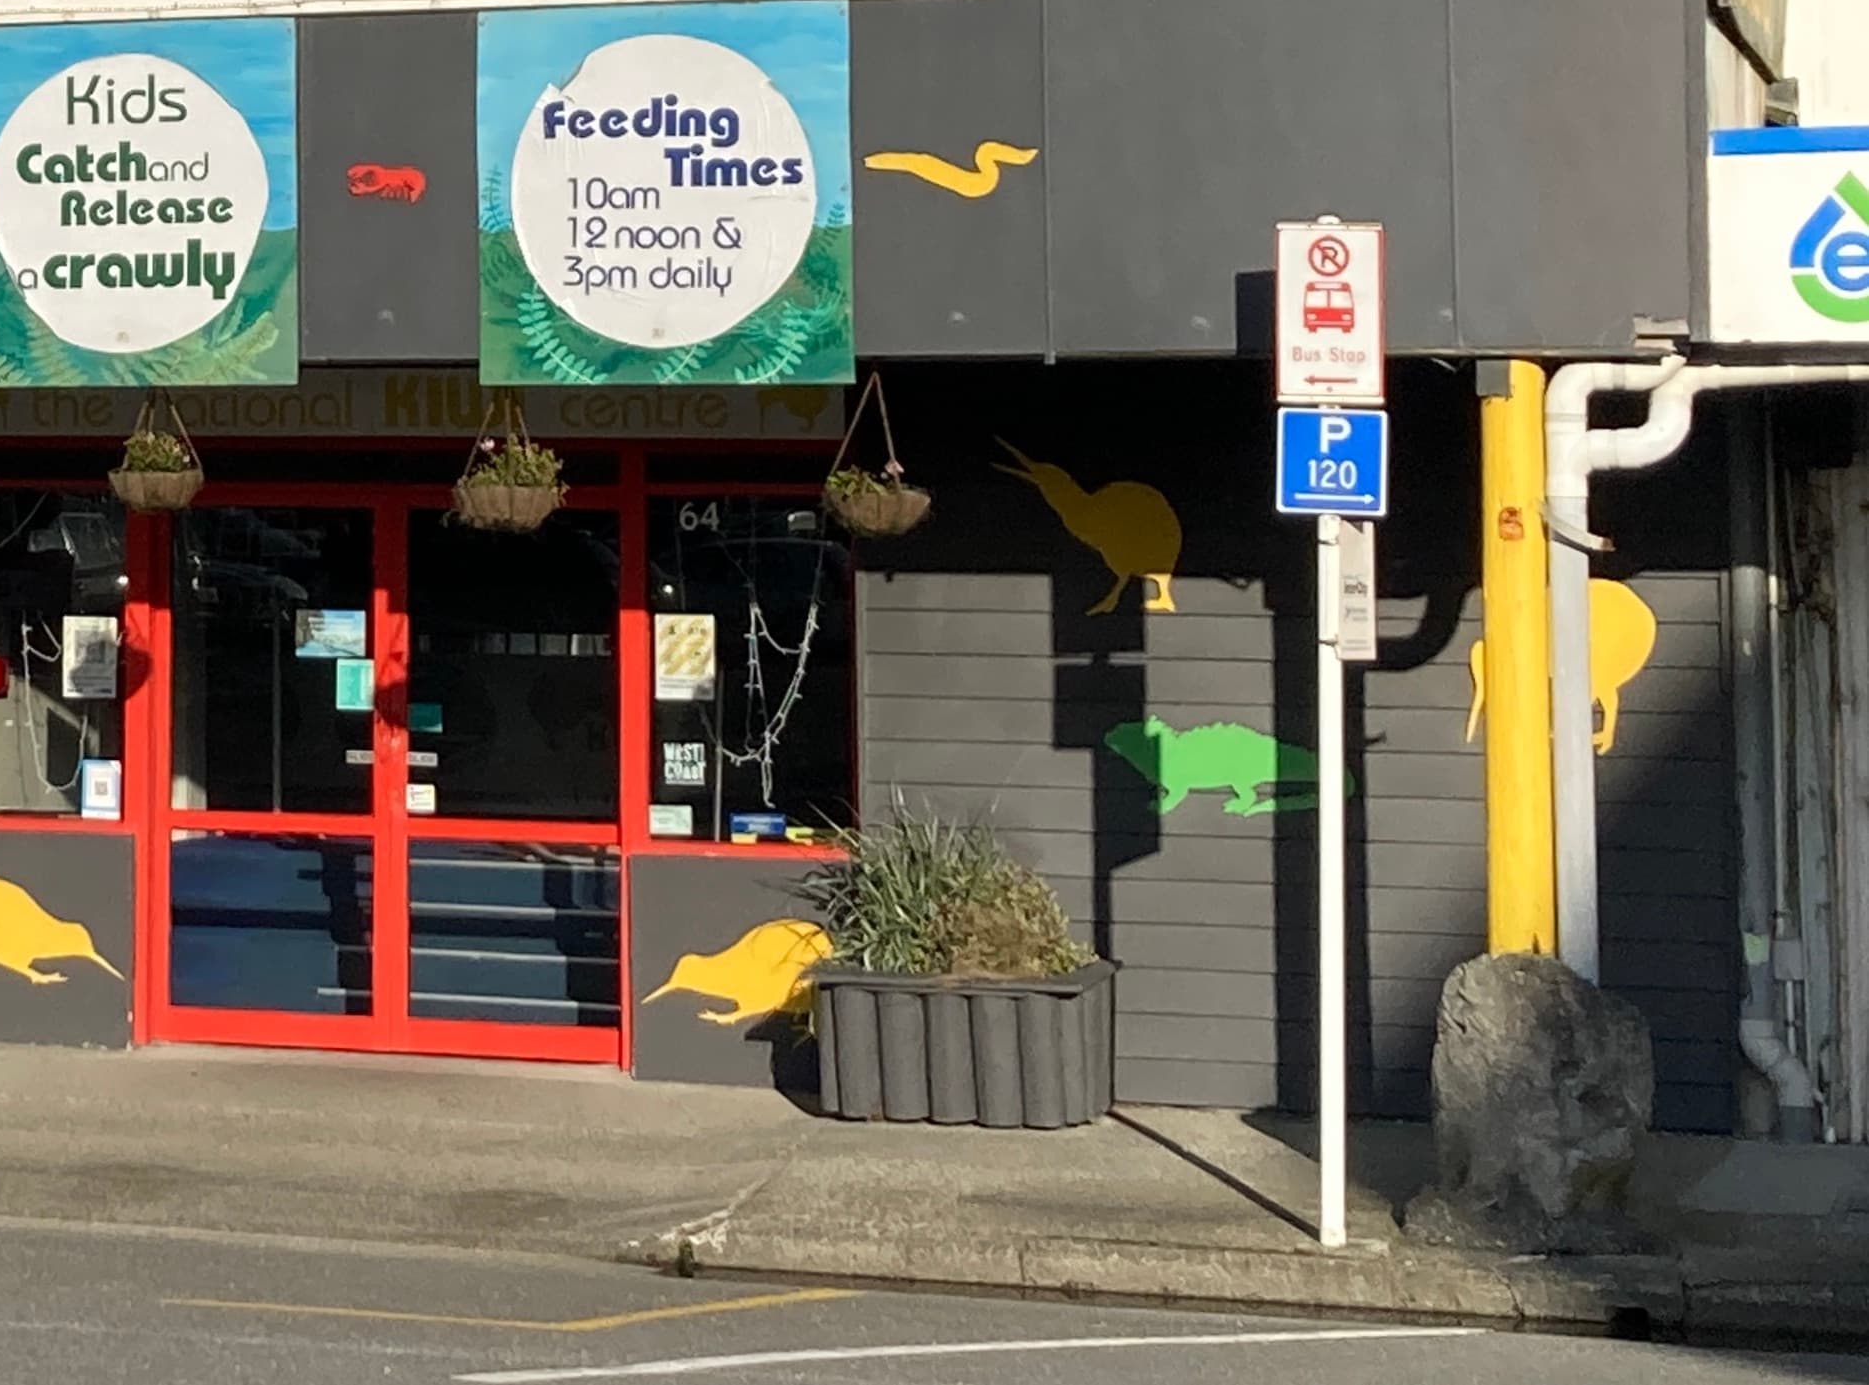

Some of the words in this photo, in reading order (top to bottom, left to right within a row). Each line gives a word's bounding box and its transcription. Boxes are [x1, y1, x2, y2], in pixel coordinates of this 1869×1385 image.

[66, 74, 187, 125] Kids
[543, 94, 739, 146] Feeding
[16, 141, 146, 184] Catch
[149, 153, 210, 182] and
[664, 146, 804, 187] Times
[60, 190, 233, 228] Release
[568, 177, 661, 210] 10am
[567, 216, 607, 248] 12
[615, 226, 700, 249] noon
[713, 217, 742, 249] &
[17, 268, 38, 291] a
[43, 238, 235, 300] crawly
[563, 255, 637, 295] 3pm
[649, 257, 733, 296] daily
[1292, 346, 1322, 363] Bus
[1329, 347, 1367, 366] Stop
[33, 387, 113, 427] the
[560, 387, 730, 429] centre
[1320, 417, 1352, 453] P
[1308, 459, 1357, 489] 120
[679, 502, 720, 531] 64
